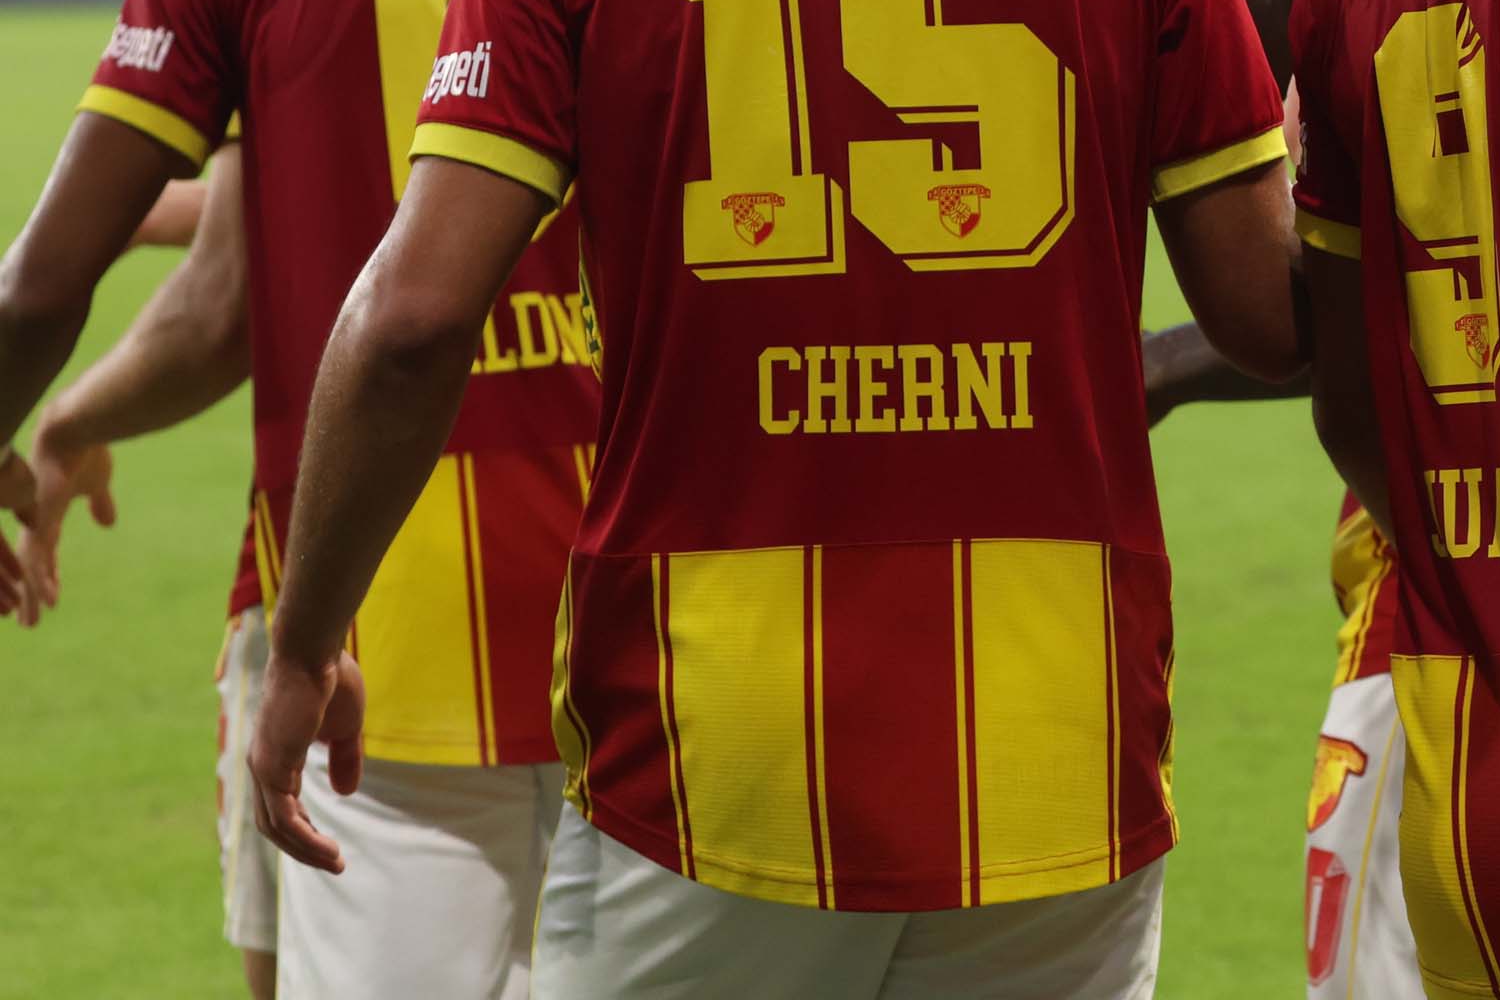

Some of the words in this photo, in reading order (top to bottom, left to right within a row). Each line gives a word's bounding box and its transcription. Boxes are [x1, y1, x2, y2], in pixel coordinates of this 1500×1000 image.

[423, 41, 492, 104] epeti
[470, 291, 592, 375] LDN
[758, 341, 1034, 435] CHERNI
